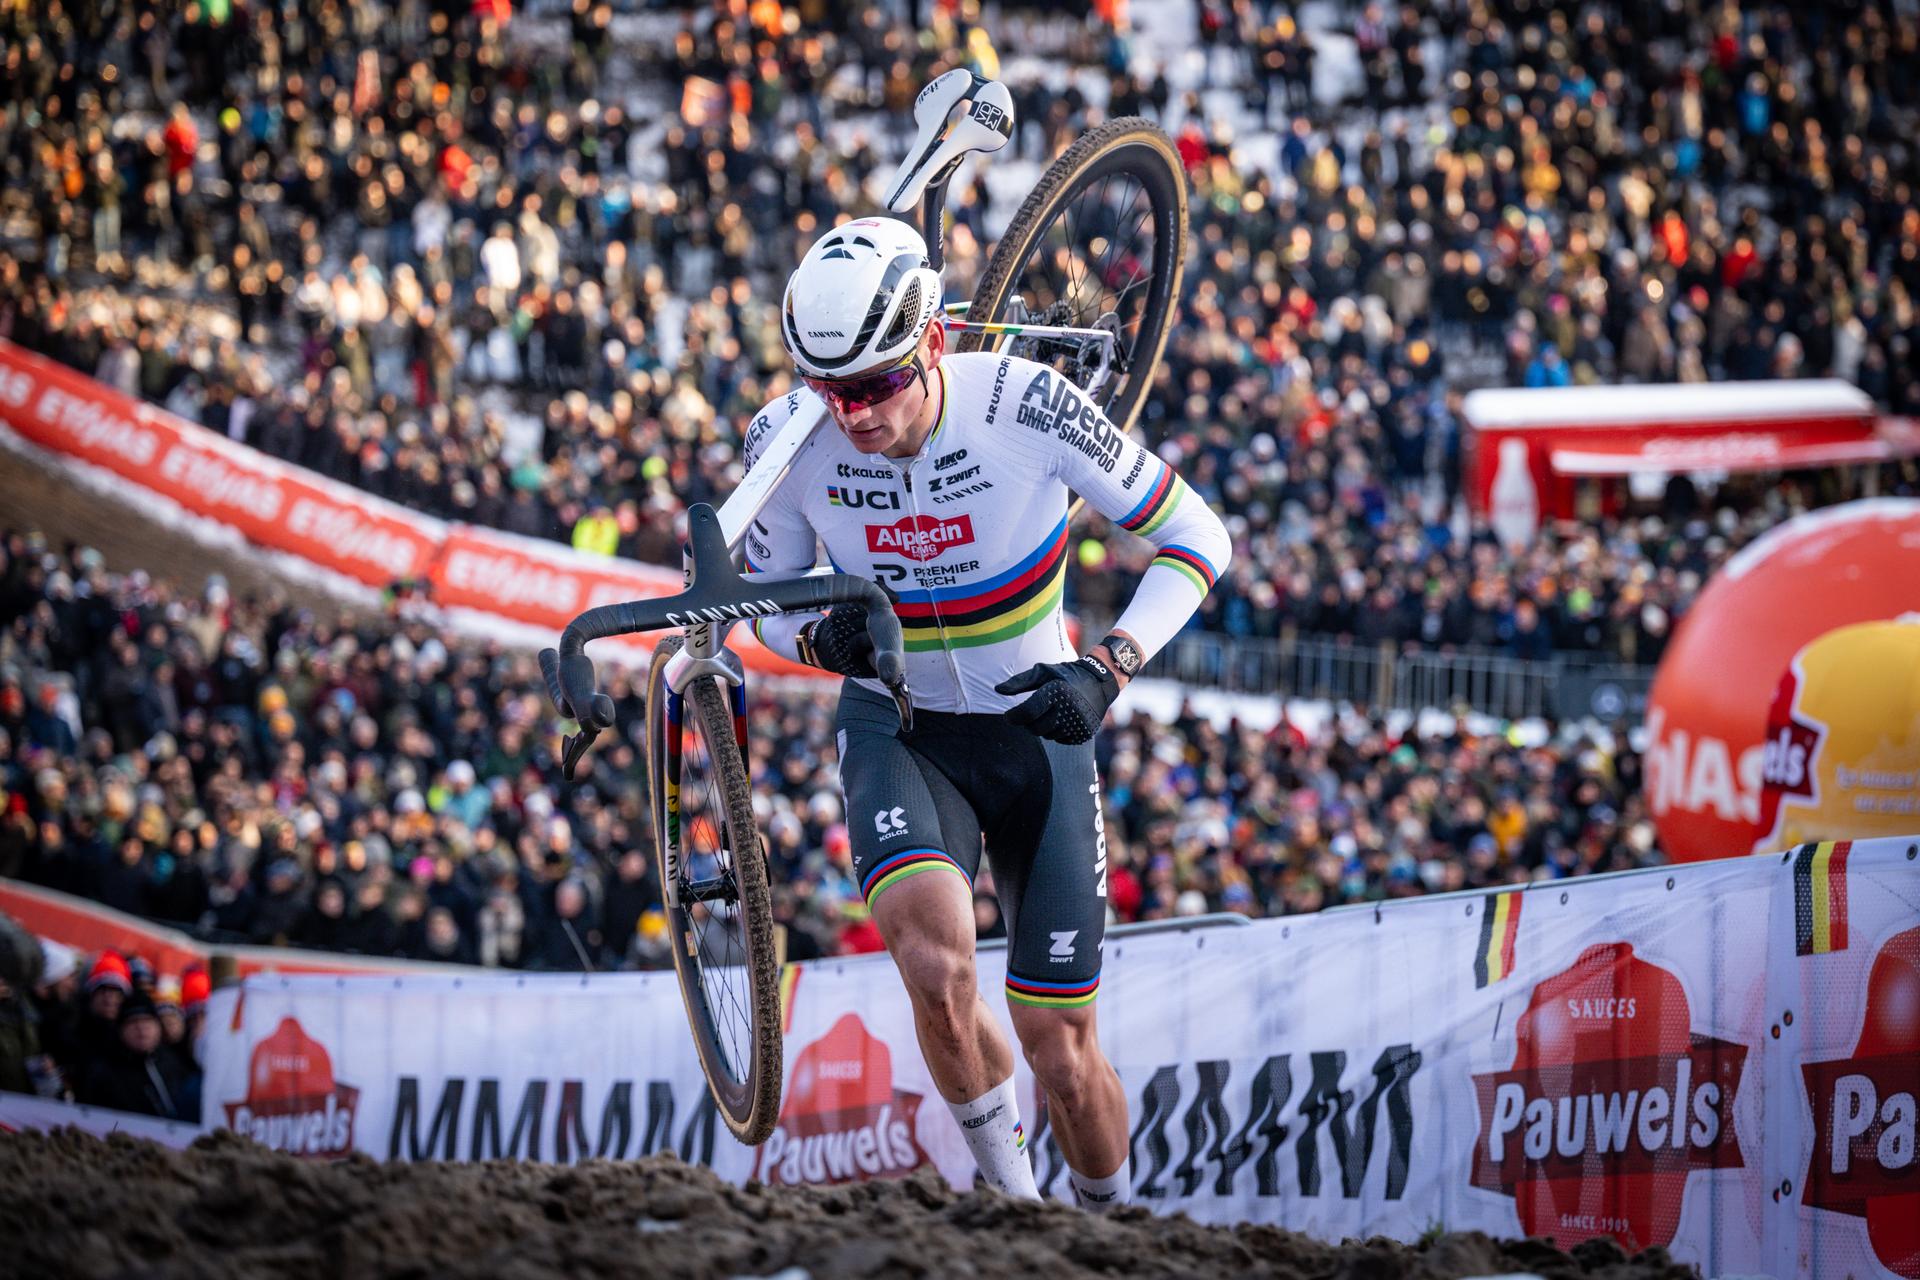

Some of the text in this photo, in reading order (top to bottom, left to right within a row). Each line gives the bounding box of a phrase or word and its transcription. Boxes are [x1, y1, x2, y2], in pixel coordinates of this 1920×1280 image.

[807, 331, 845, 339] CANYON
[1021, 369, 1124, 460] Alpecin
[1016, 403, 1116, 474] DMG SHAMPOO
[946, 465, 981, 486] ZWIFT
[840, 487, 900, 510] UCI
[933, 480, 994, 504] CANYON
[876, 522, 963, 551] Alpecin
[911, 543, 938, 555] DMG
[913, 560, 980, 577] PREMIER
[916, 575, 956, 588] TECH
[665, 599, 783, 627] CANYON
[1568, 997, 1636, 1019] SAUCES
[1489, 1058, 1721, 1162] Pauwels
[758, 1104, 919, 1187] Pauwels
[1561, 1214, 1630, 1232] SINCE 1909
